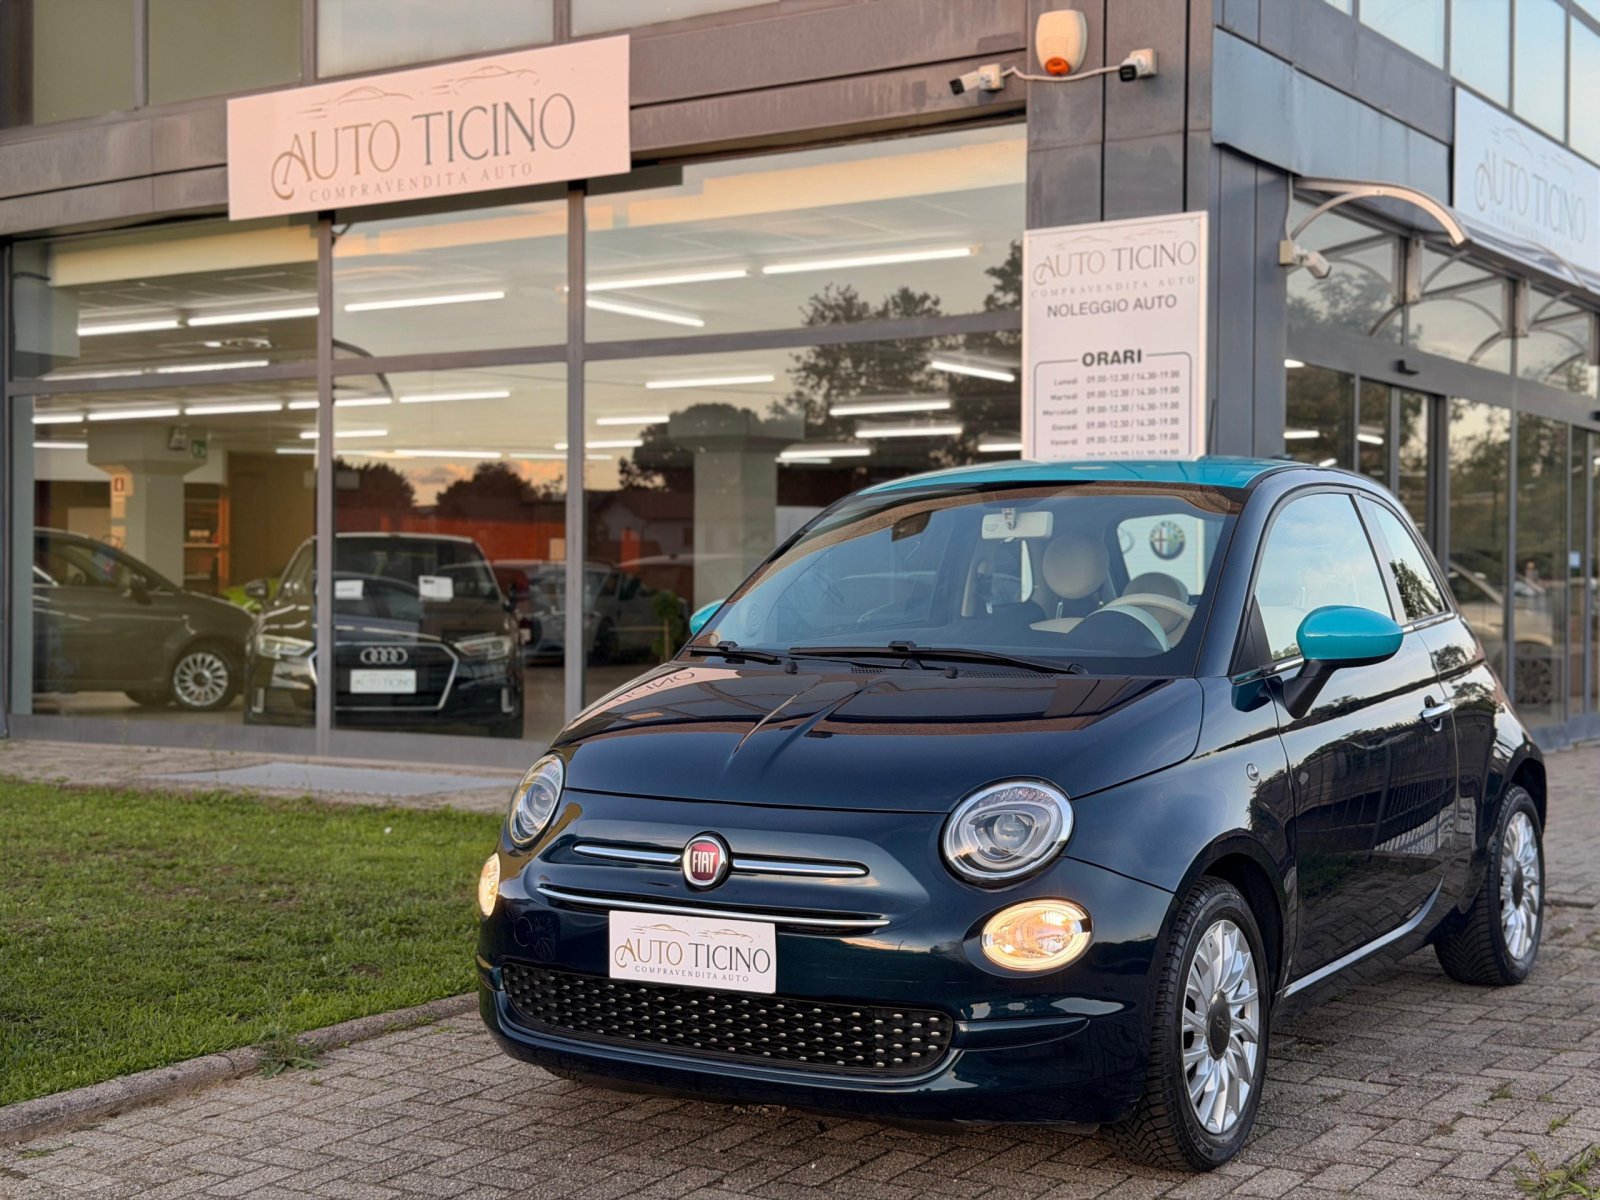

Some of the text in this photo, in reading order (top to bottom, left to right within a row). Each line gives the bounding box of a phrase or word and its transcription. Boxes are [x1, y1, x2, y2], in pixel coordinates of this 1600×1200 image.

[271, 93, 575, 200] AUTO TICINO
[309, 162, 533, 203] COMPRAVENDITA AUTO
[1475, 149, 1529, 216] AUTO
[1532, 172, 1586, 243] TICINO
[1033, 240, 1197, 286] AUTO TICINO
[1031, 275, 1196, 299] COMPRAVENDITA AUTO
[1047, 294, 1177, 318] NOLEGGIO AUTO
[1081, 348, 1142, 367] ORARI
[692, 850, 716, 874] FIAT
[614, 938, 771, 974] AUTO TICINO
[634, 965, 749, 983] COMPRAVENDITA AUTO
